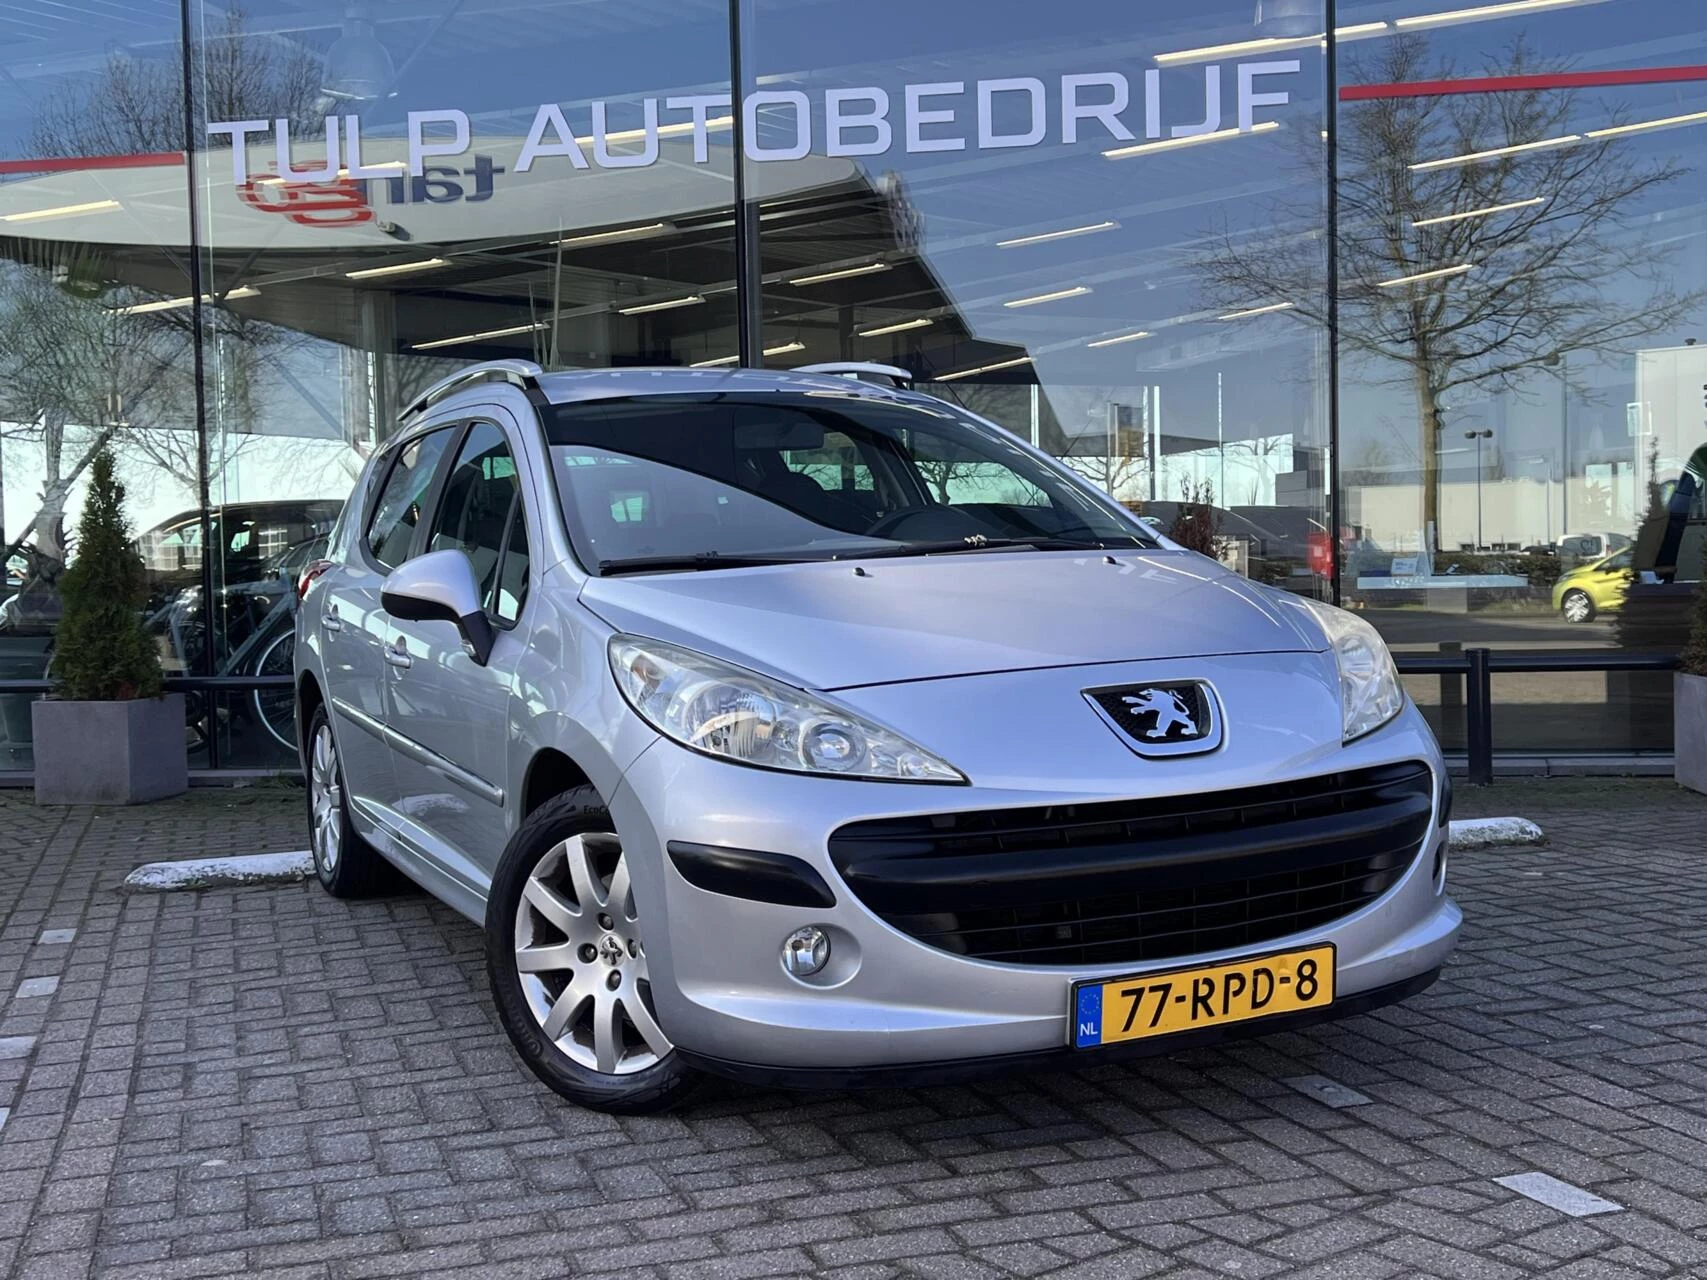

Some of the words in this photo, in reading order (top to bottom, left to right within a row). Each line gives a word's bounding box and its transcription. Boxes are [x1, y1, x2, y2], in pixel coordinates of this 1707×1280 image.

[208, 109, 470, 185] TULP
[514, 60, 1301, 172] AUTOBEDRIJF
[1080, 1022, 1098, 1037] NL
[1120, 958, 1318, 1033] 77-RPD-8
